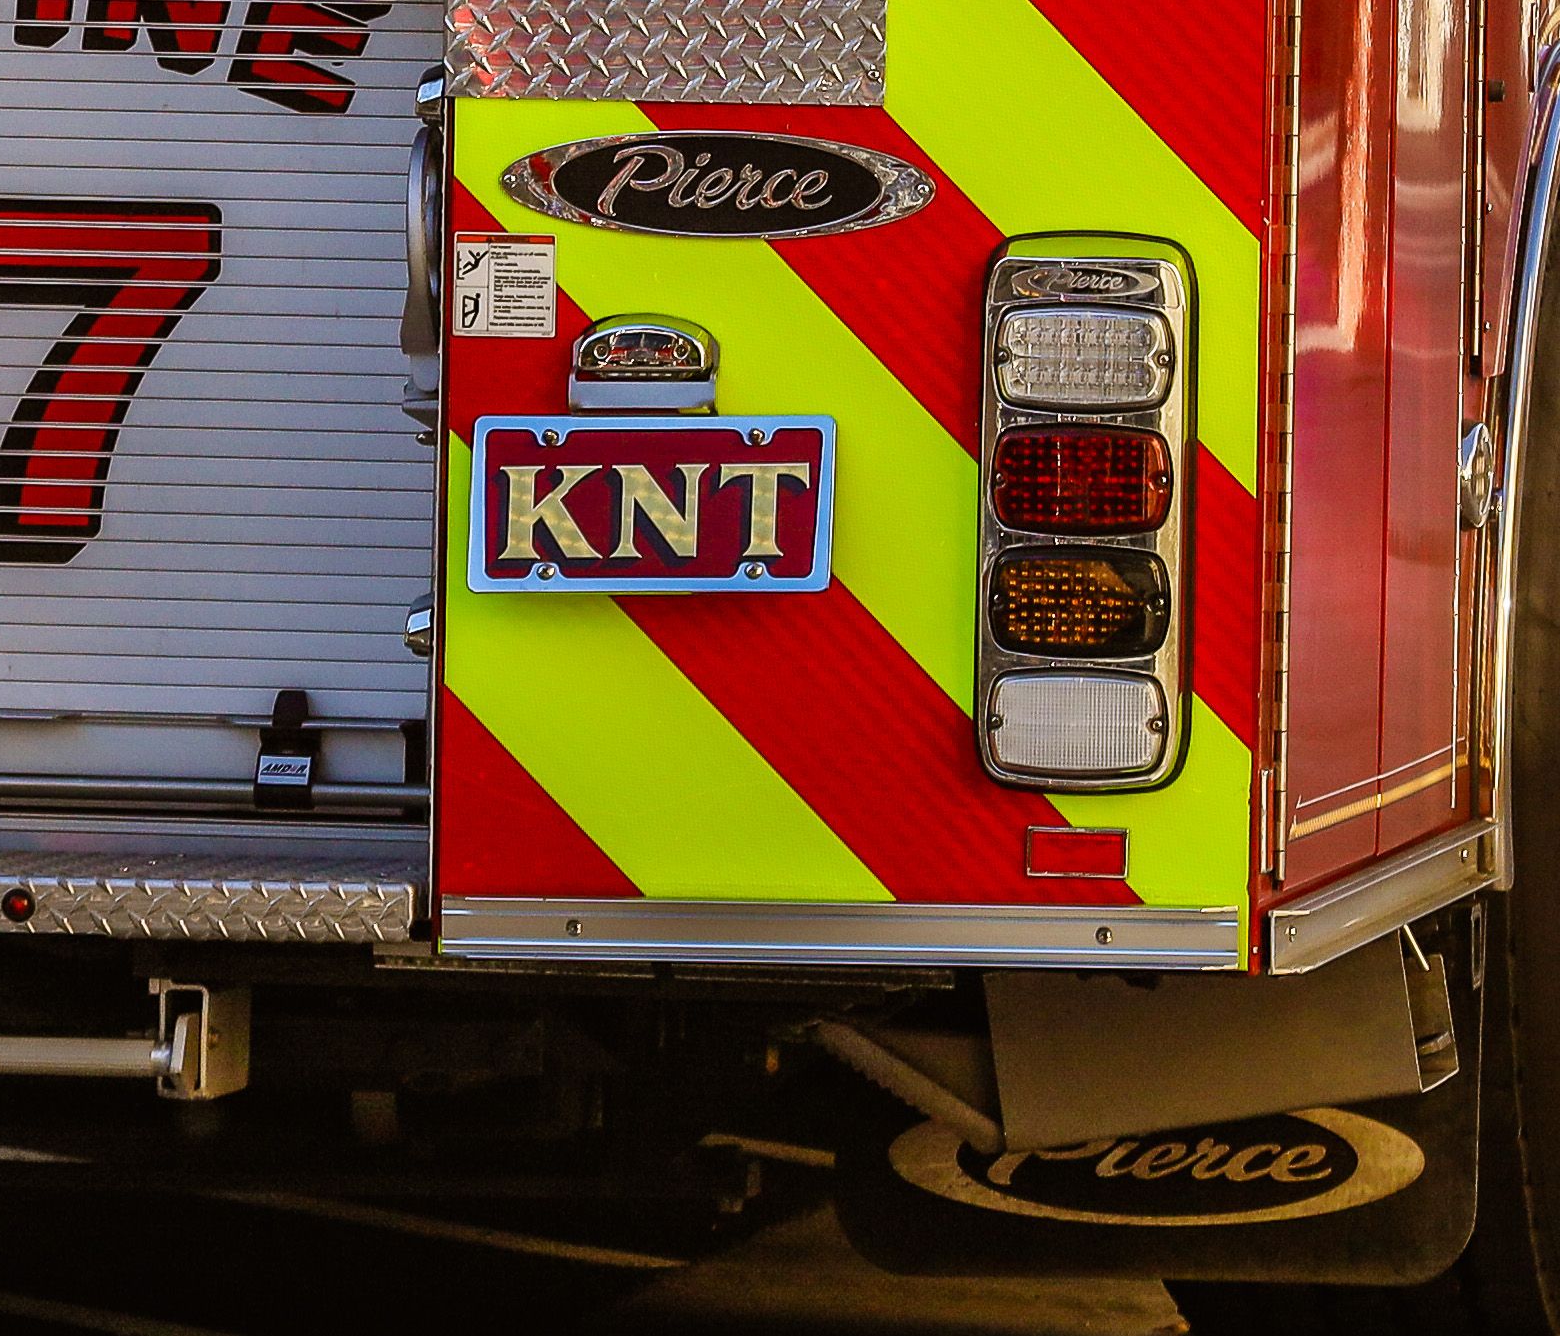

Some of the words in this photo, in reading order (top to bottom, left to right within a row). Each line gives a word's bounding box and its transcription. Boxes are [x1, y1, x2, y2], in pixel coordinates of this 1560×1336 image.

[598, 143, 836, 216] Pierce
[1046, 268, 1124, 291] Pierce
[496, 462, 813, 561] KNT
